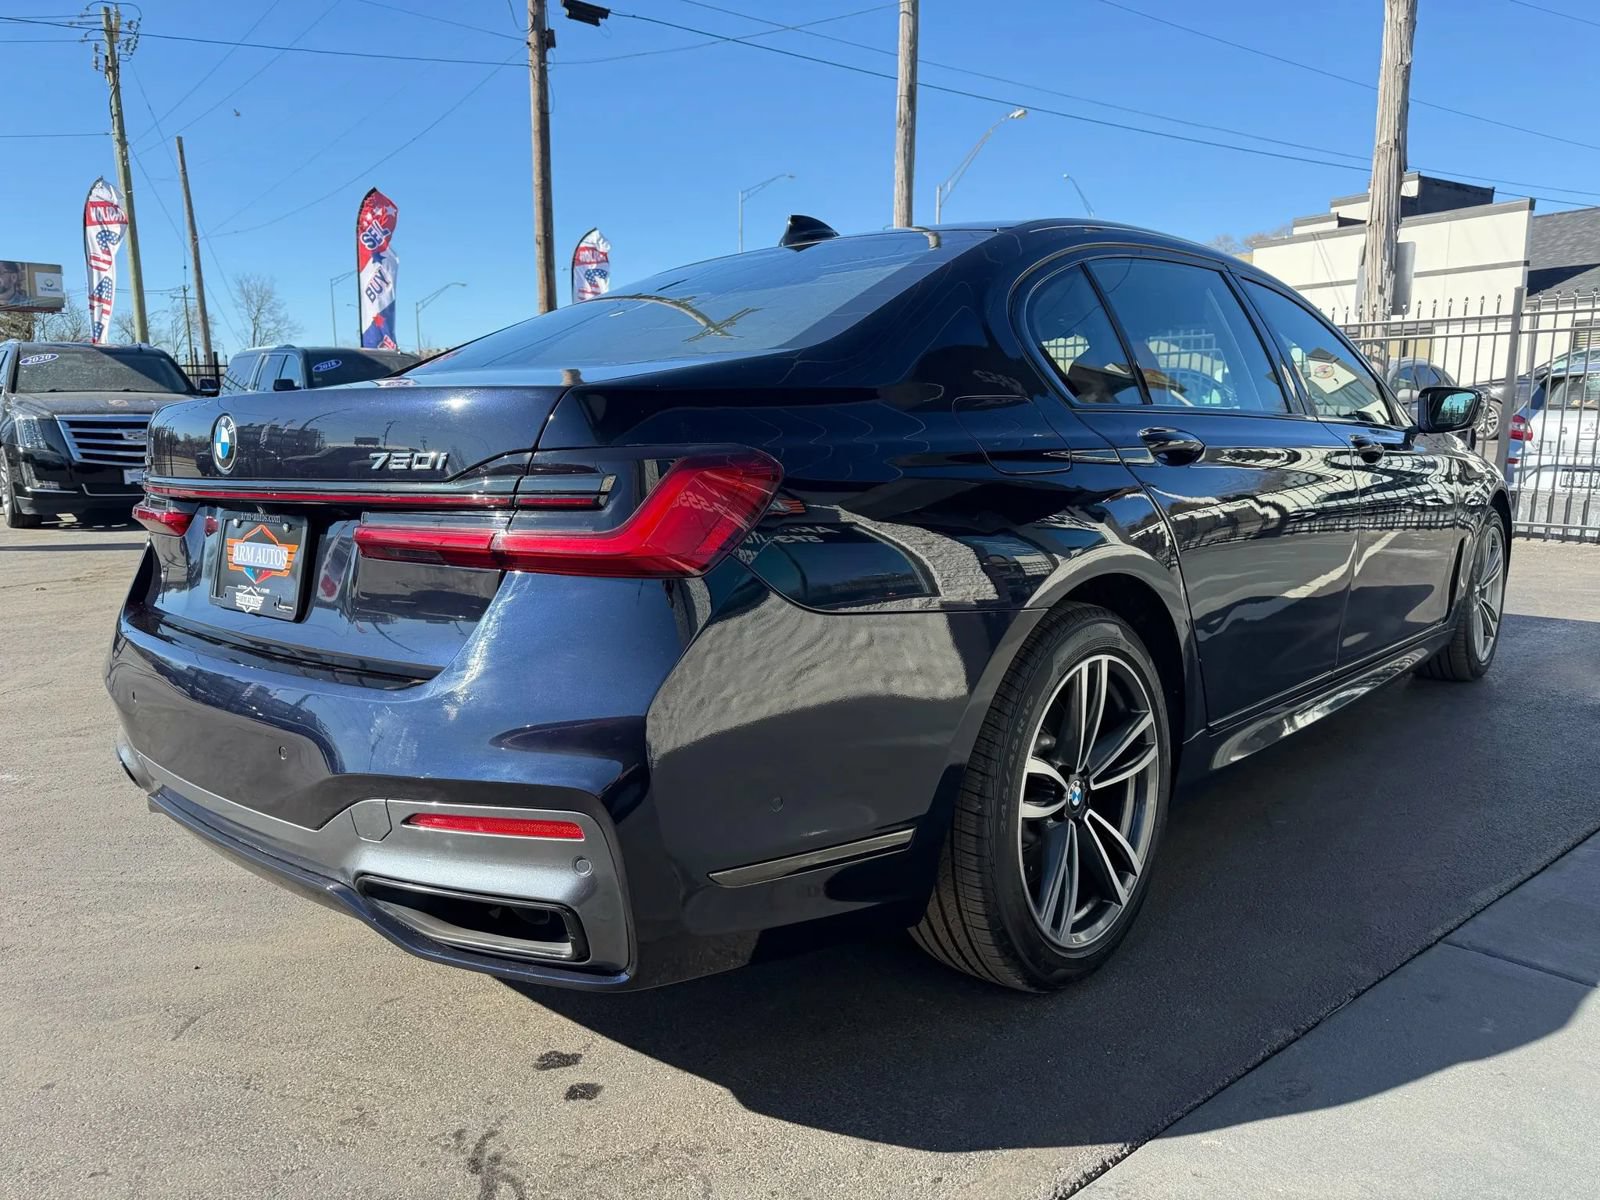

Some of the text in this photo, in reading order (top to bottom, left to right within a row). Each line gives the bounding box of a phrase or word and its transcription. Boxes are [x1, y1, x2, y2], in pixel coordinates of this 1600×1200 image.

[366, 268, 389, 303] BUY
[369, 452, 449, 470] 750i
[233, 544, 288, 567] ARM AUTOS
